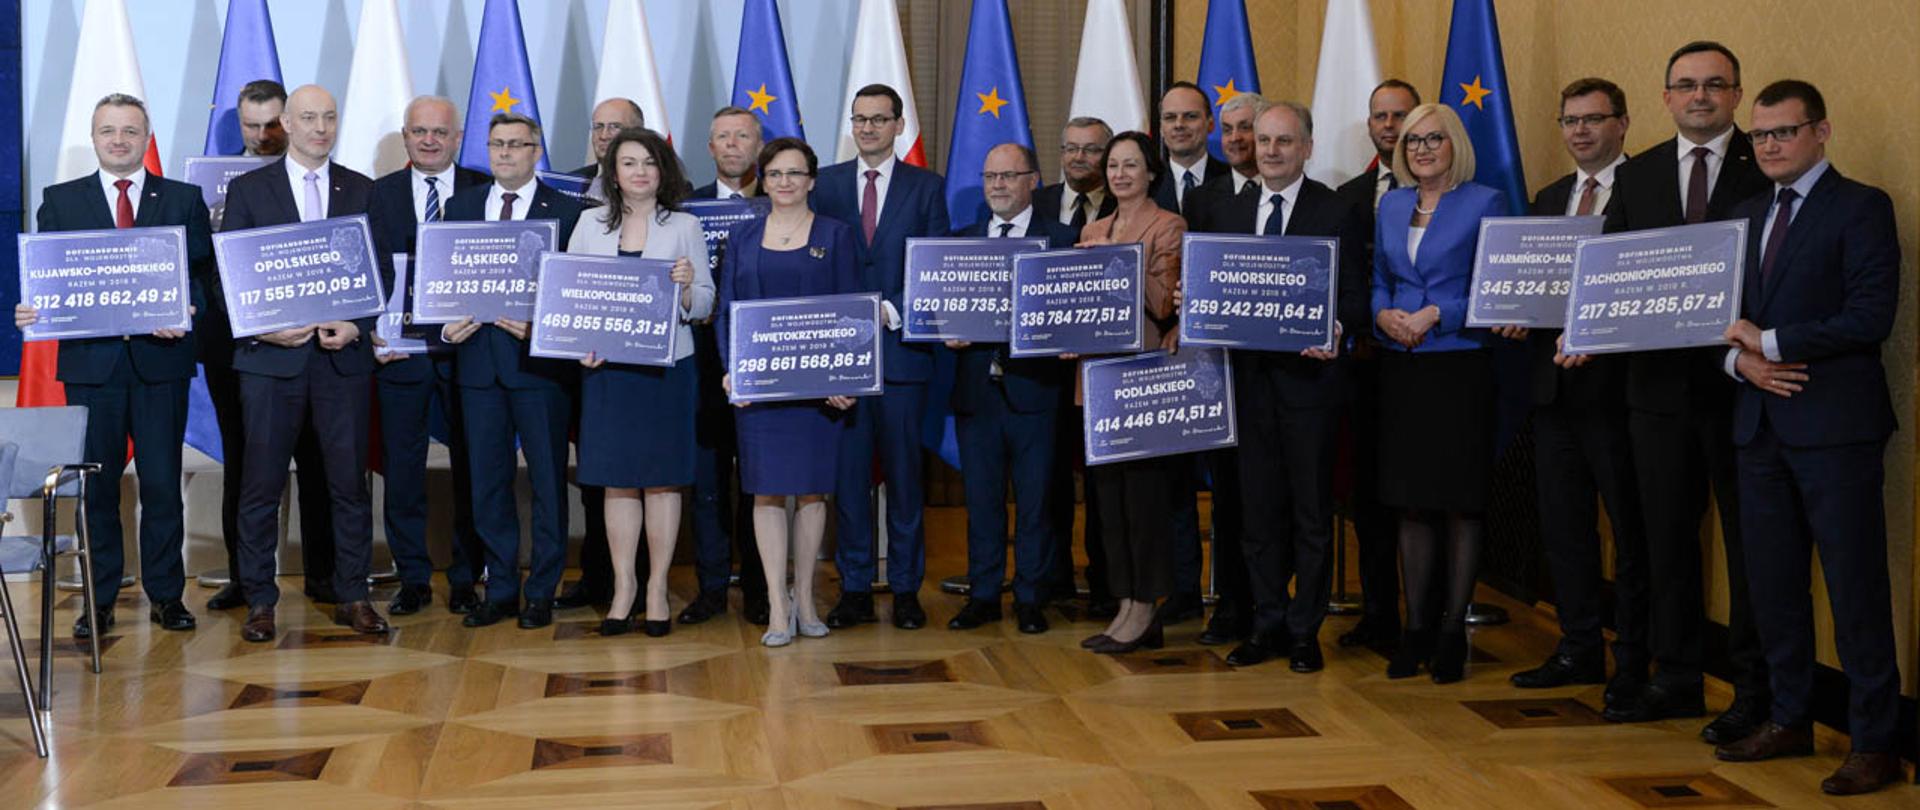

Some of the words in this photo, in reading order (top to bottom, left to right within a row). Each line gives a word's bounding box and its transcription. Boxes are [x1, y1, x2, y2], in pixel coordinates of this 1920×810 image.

[254, 251, 340, 272] OPOLSKIEGO
[451, 252, 518, 267] ŚLĄSKIEGO
[1489, 251, 1575, 264] WARMIŃSKO-MA
[30, 263, 175, 278] KUJAWSKO-POMORSKIEGO
[920, 270, 1012, 282] MAZOWIECKIE
[1210, 271, 1306, 285] POMORSKIEGO
[1584, 262, 1725, 286] ZACHODNIOPOMORSKIEGO
[240, 290, 260, 305] 117
[265, 285, 295, 300] 555
[299, 277, 350, 296] 720,09
[354, 273, 367, 288] zł
[426, 281, 452, 293] 292
[456, 281, 479, 293] 133
[482, 280, 525, 296] 514,18
[528, 282, 538, 292] z
[561, 288, 653, 303] WIELKOPOLSKIEGO
[1022, 278, 1129, 296] PODKARPACKIEGO
[1481, 281, 1512, 295] 345
[1515, 281, 1546, 295] 324
[1550, 281, 1570, 295] 33
[33, 295, 60, 309] 312
[65, 292, 94, 307] 418
[100, 289, 158, 306] 662,49
[163, 287, 178, 301] zł
[913, 298, 940, 311] 620
[944, 298, 967, 311] 168
[971, 298, 1012, 314] 735,3
[1578, 304, 1606, 320] 217
[1609, 301, 1640, 317] 352
[1644, 294, 1705, 314] 285,67
[1708, 292, 1724, 308] zł
[1020, 311, 1044, 327] 336
[1047, 310, 1072, 325] 784
[1075, 307, 1115, 324] 727,51
[1118, 306, 1130, 321] zł
[1189, 299, 1218, 314] 259
[1222, 301, 1251, 316] 242
[1254, 303, 1304, 321] 291,64
[1308, 305, 1323, 319] zł
[542, 314, 570, 327] 469
[573, 315, 601, 330] 855
[604, 318, 651, 335] 556,31
[653, 321, 668, 335] zł
[752, 328, 856, 343] ŚWIĘTOKRZYSKIEGO
[738, 358, 767, 372] 298
[770, 356, 797, 370] 661
[801, 353, 854, 370] 568,86
[857, 351, 871, 366] zł
[1115, 379, 1195, 400] PODLASKIEGO
[1095, 417, 1120, 432] 414
[1124, 412, 1153, 428] 446
[1158, 405, 1204, 425] 674,51
[1208, 402, 1222, 417] zł
